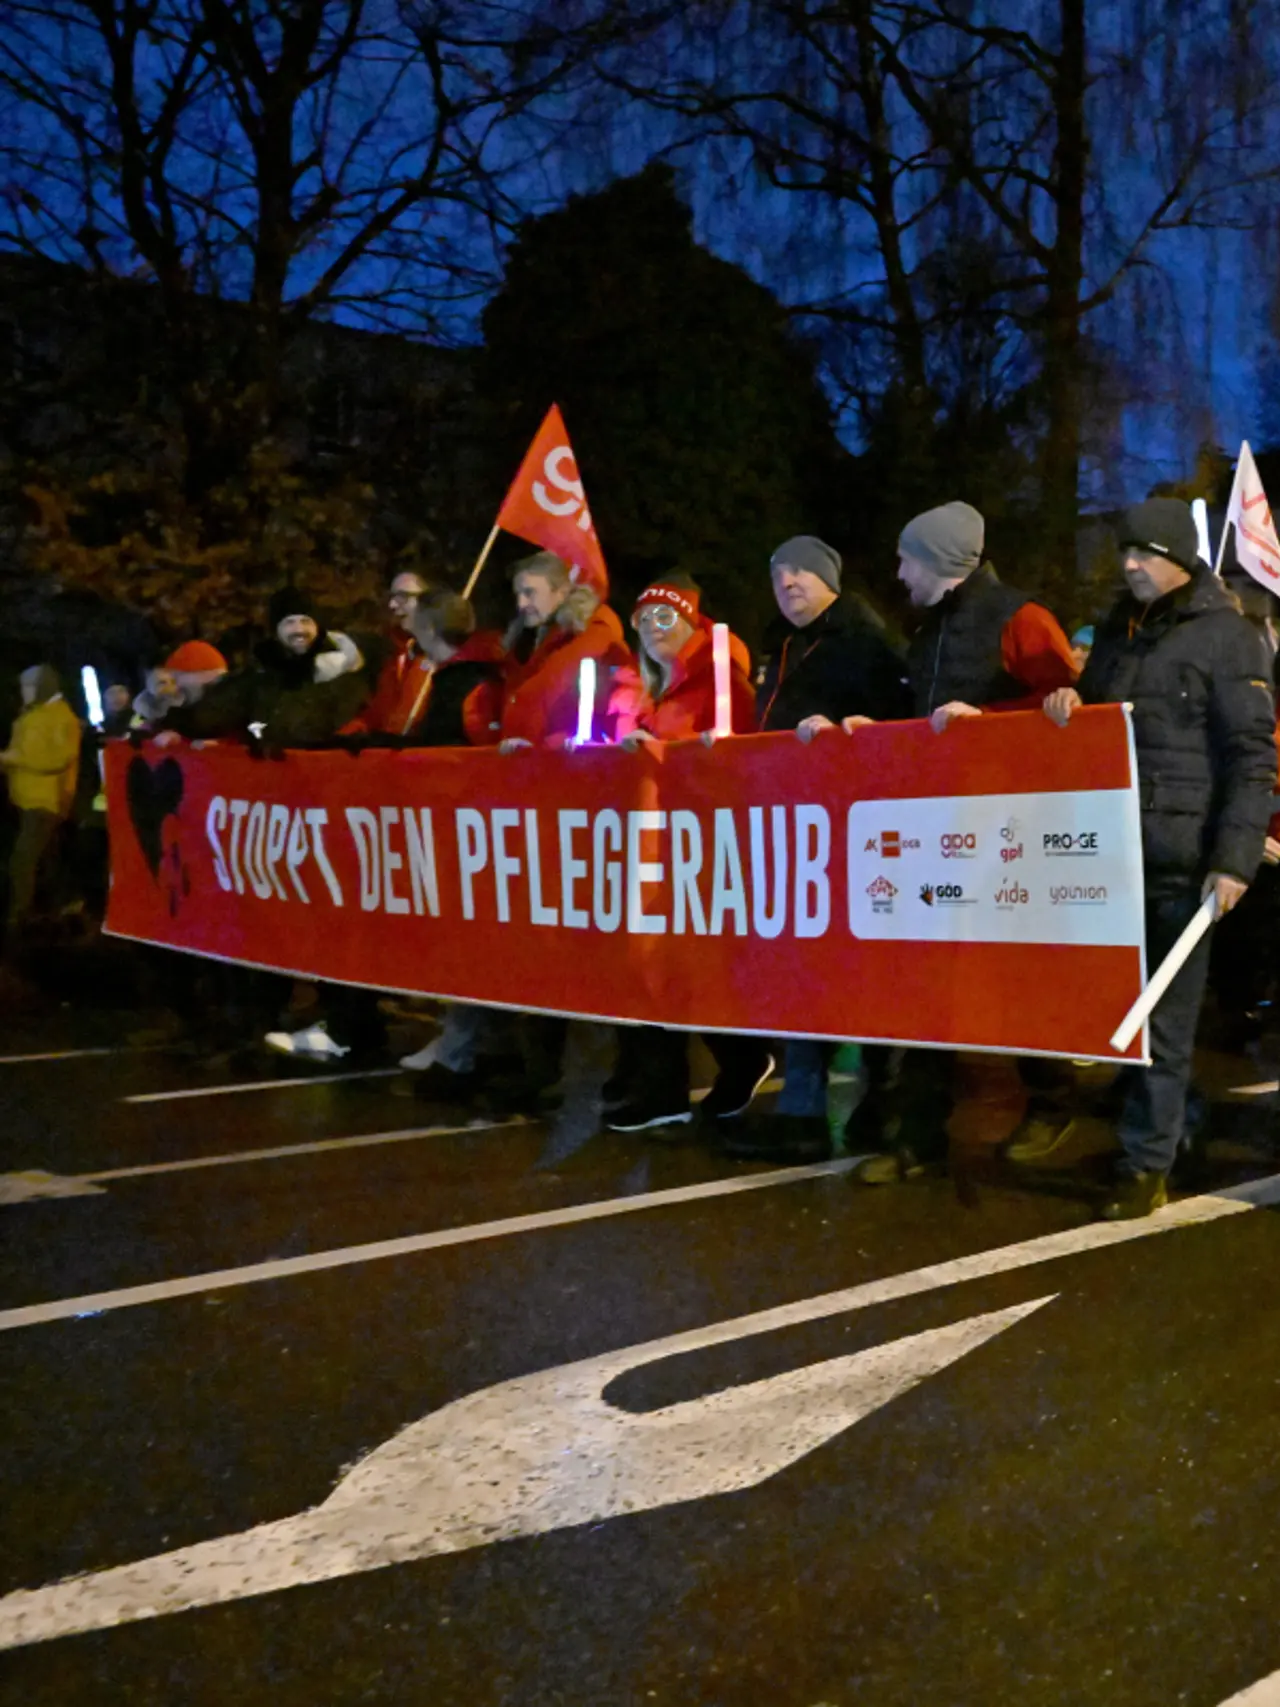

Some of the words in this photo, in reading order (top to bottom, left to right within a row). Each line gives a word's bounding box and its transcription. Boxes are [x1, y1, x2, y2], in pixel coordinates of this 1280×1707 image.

[206, 796, 343, 907] STOPPT
[346, 807, 441, 917] DEN
[456, 803, 831, 938] PFLEGERAUB
[994, 877, 1029, 904] vida
